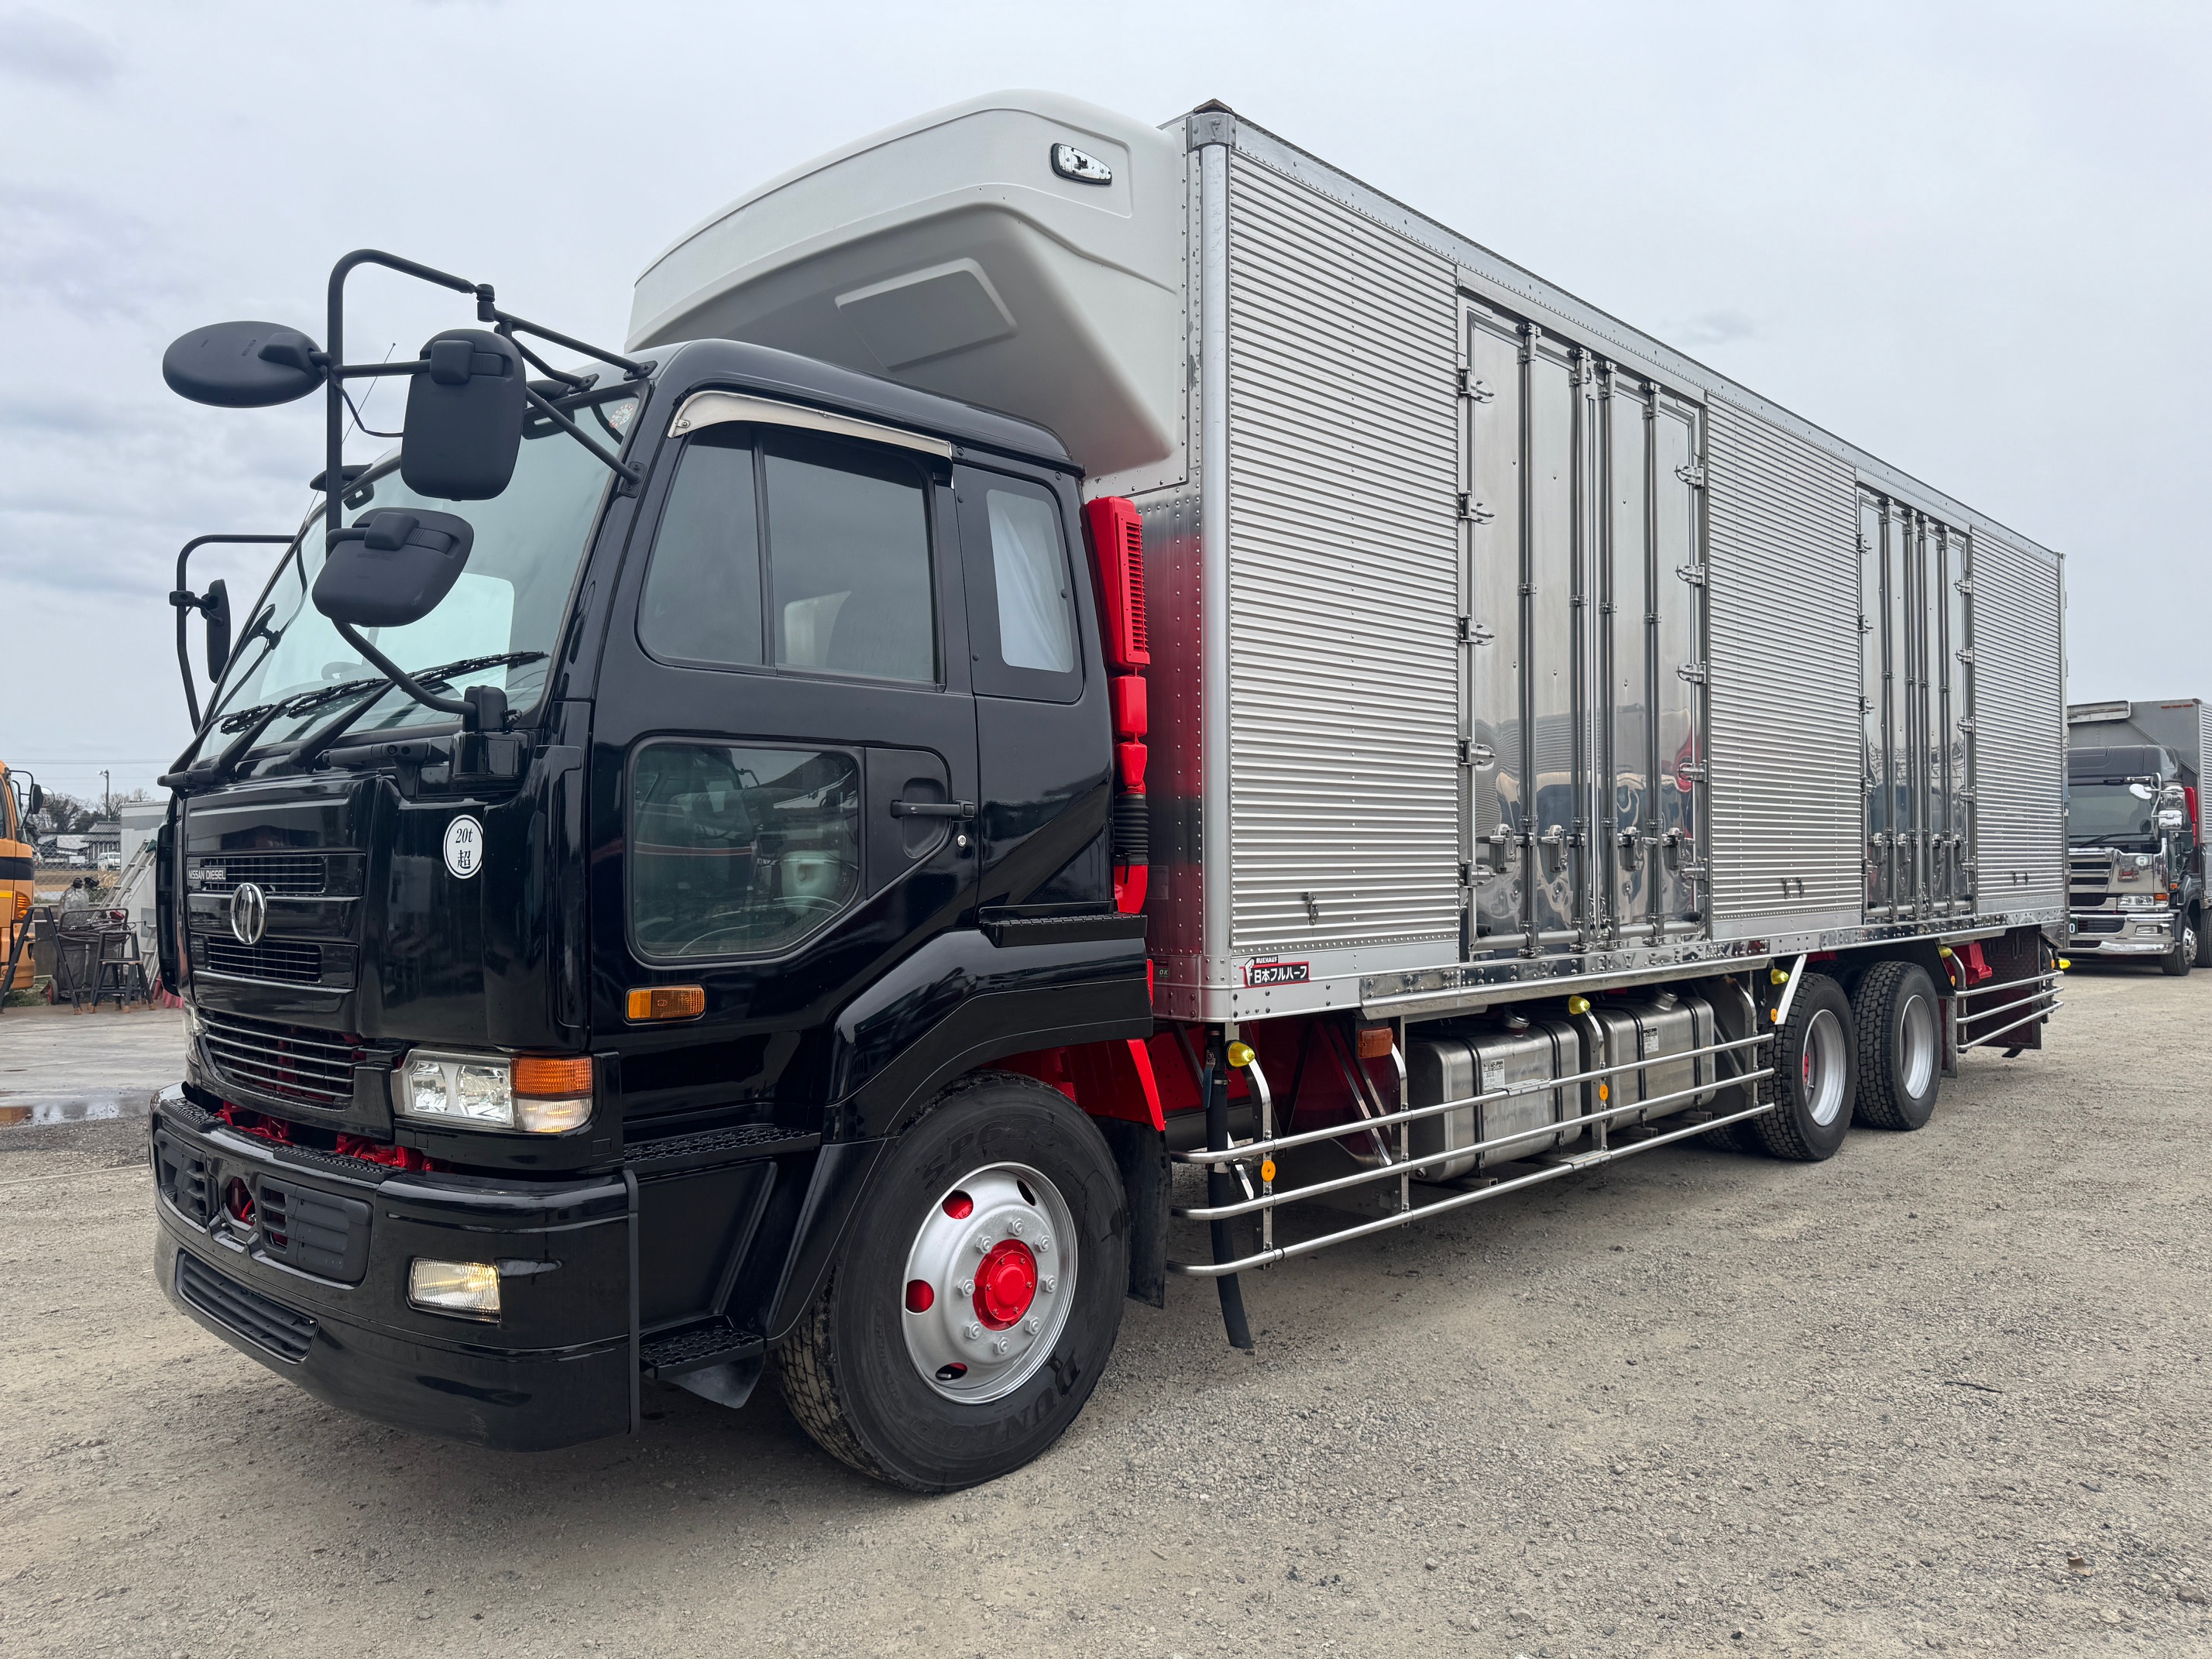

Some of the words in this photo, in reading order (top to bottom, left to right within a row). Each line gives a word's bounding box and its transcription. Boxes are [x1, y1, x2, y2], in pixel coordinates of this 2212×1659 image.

[455, 828, 473, 843] 20t
[457, 850, 472, 869] 超
[188, 869, 204, 880] NISSAN
[205, 869, 226, 881] DIESEL
[1254, 965, 1307, 984] 日本フルハーフ
[908, 1351, 1081, 1453] DUNLOP
